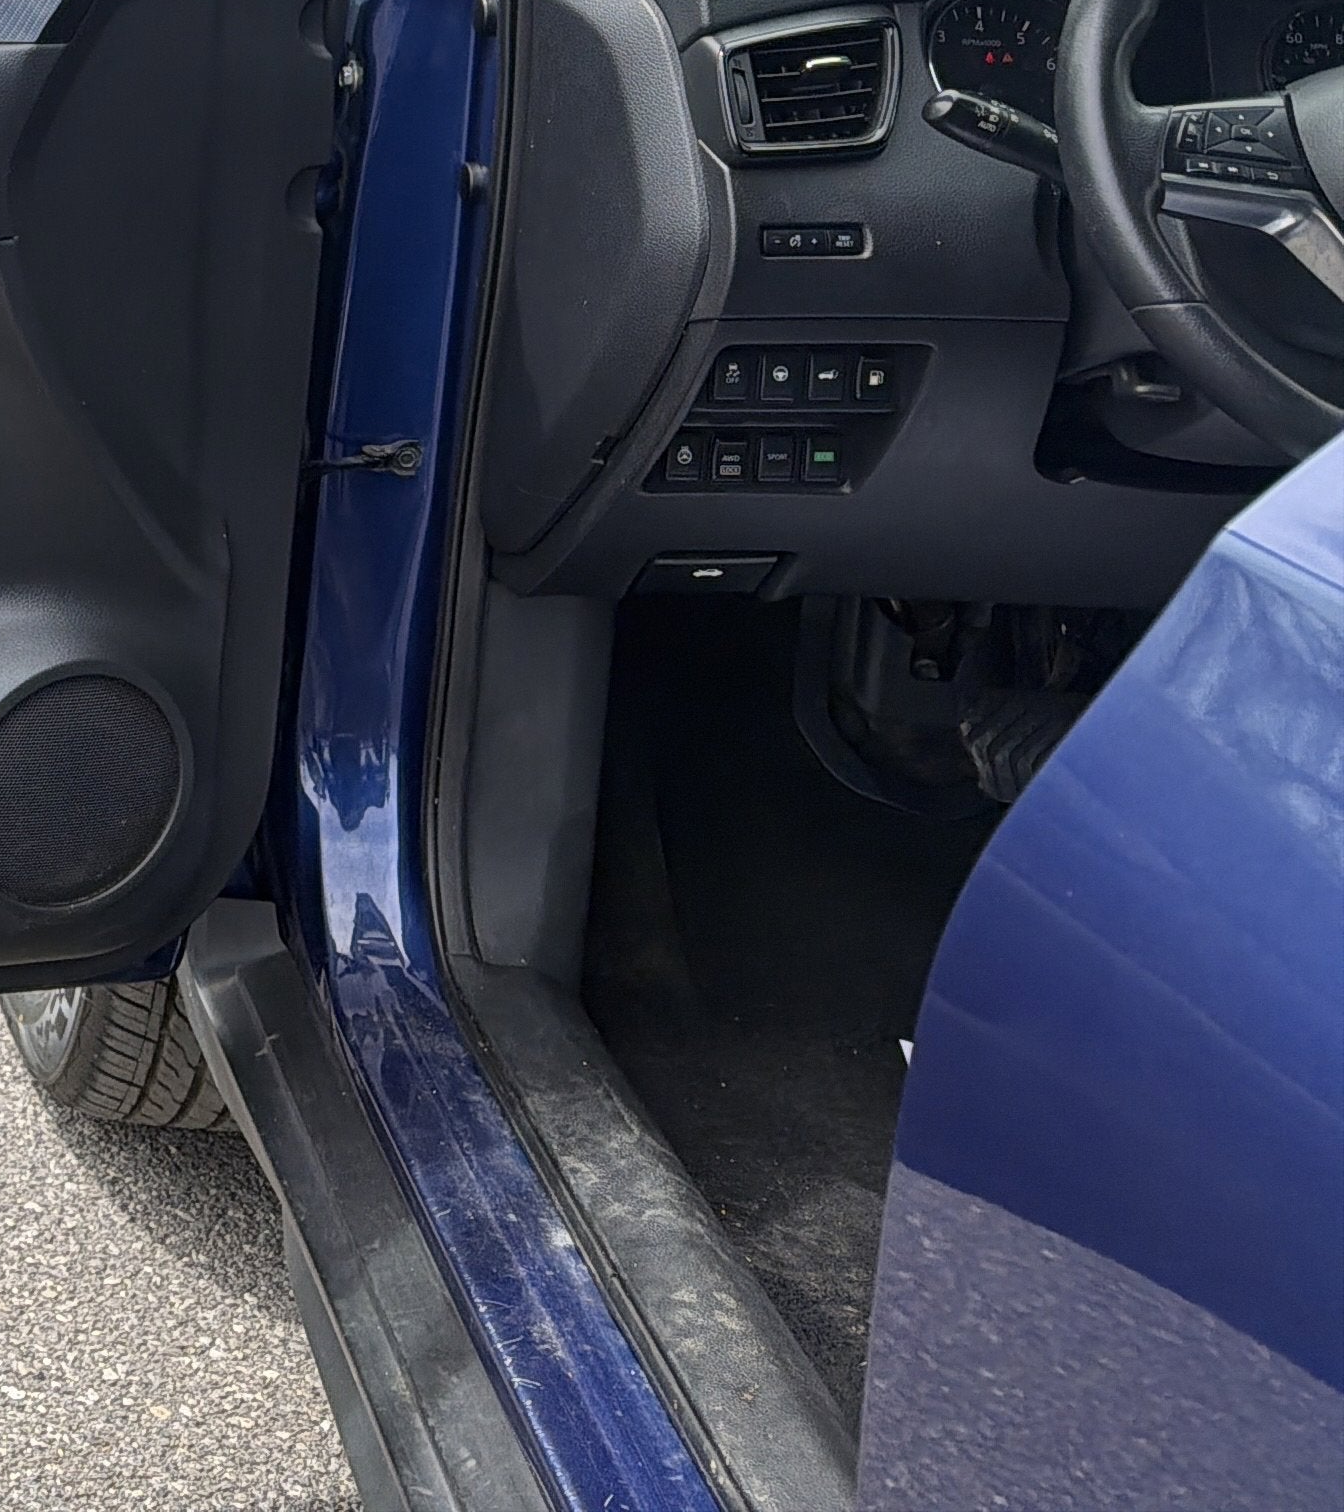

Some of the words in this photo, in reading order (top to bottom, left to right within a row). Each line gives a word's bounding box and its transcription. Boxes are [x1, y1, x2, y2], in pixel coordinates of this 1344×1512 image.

[974, 20, 985, 33] 4
[937, 30, 946, 43] 3
[1016, 32, 1026, 45] 5
[1286, 33, 1302, 44] 60
[1335, 33, 1344, 45] 8
[1046, 58, 1056, 71] 6
